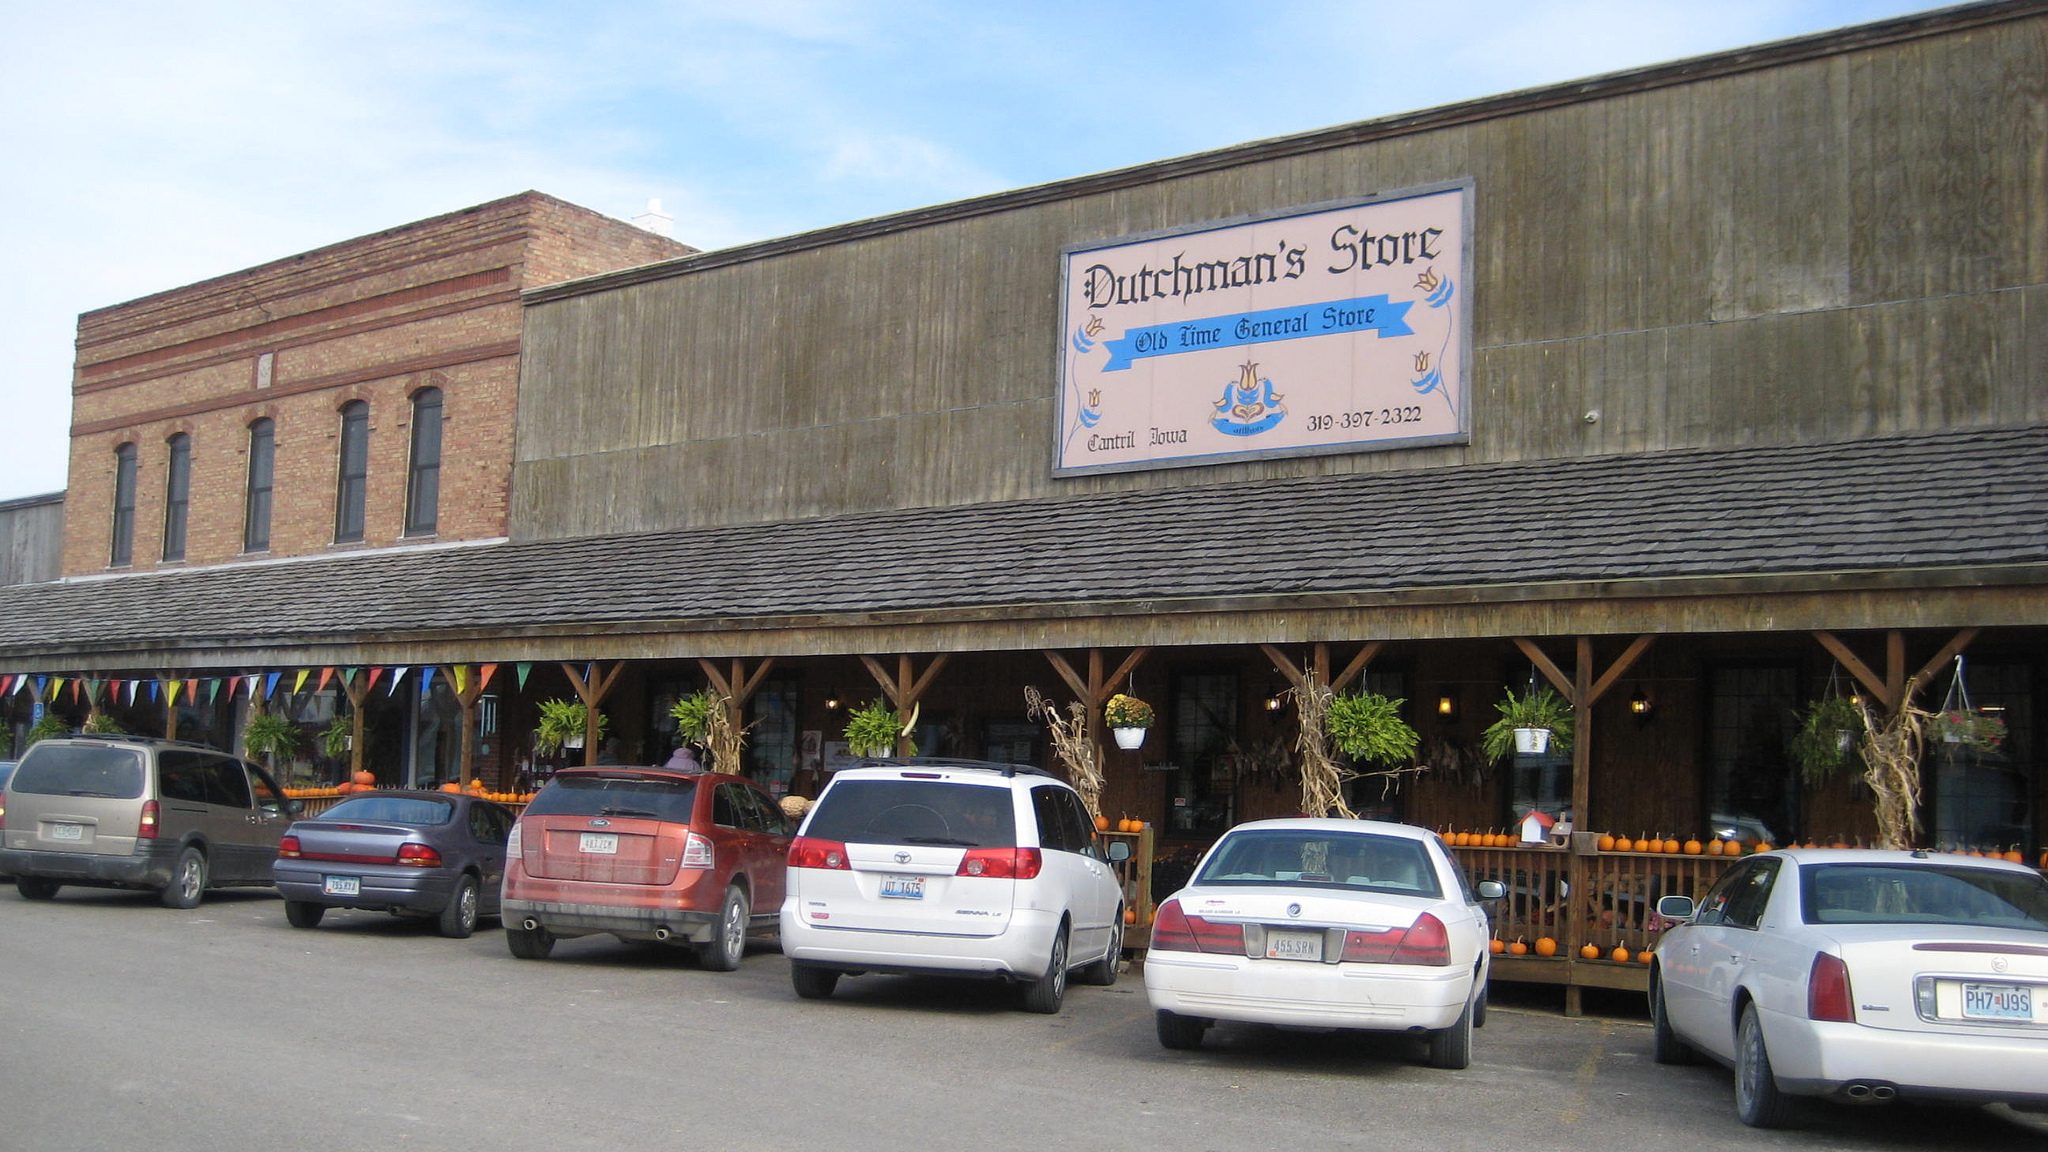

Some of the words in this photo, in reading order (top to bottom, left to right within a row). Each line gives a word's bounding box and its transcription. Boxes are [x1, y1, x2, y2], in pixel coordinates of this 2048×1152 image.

[1084, 240, 1308, 311] Dutchman's
[1327, 224, 1443, 275] Store
[1135, 328, 1168, 353] Old
[1178, 323, 1221, 347] Time
[1234, 316, 1308, 341] General
[1322, 306, 1376, 330] Store
[1306, 406, 1422, 432] 319-397-2322
[1087, 429, 1136, 453] Cantril
[1149, 427, 1188, 446] Iowa
[885, 881, 896, 893] UT
[901, 882, 921, 895] 1675
[1274, 939, 1293, 953] 455
[1966, 991, 1993, 1010] PH7
